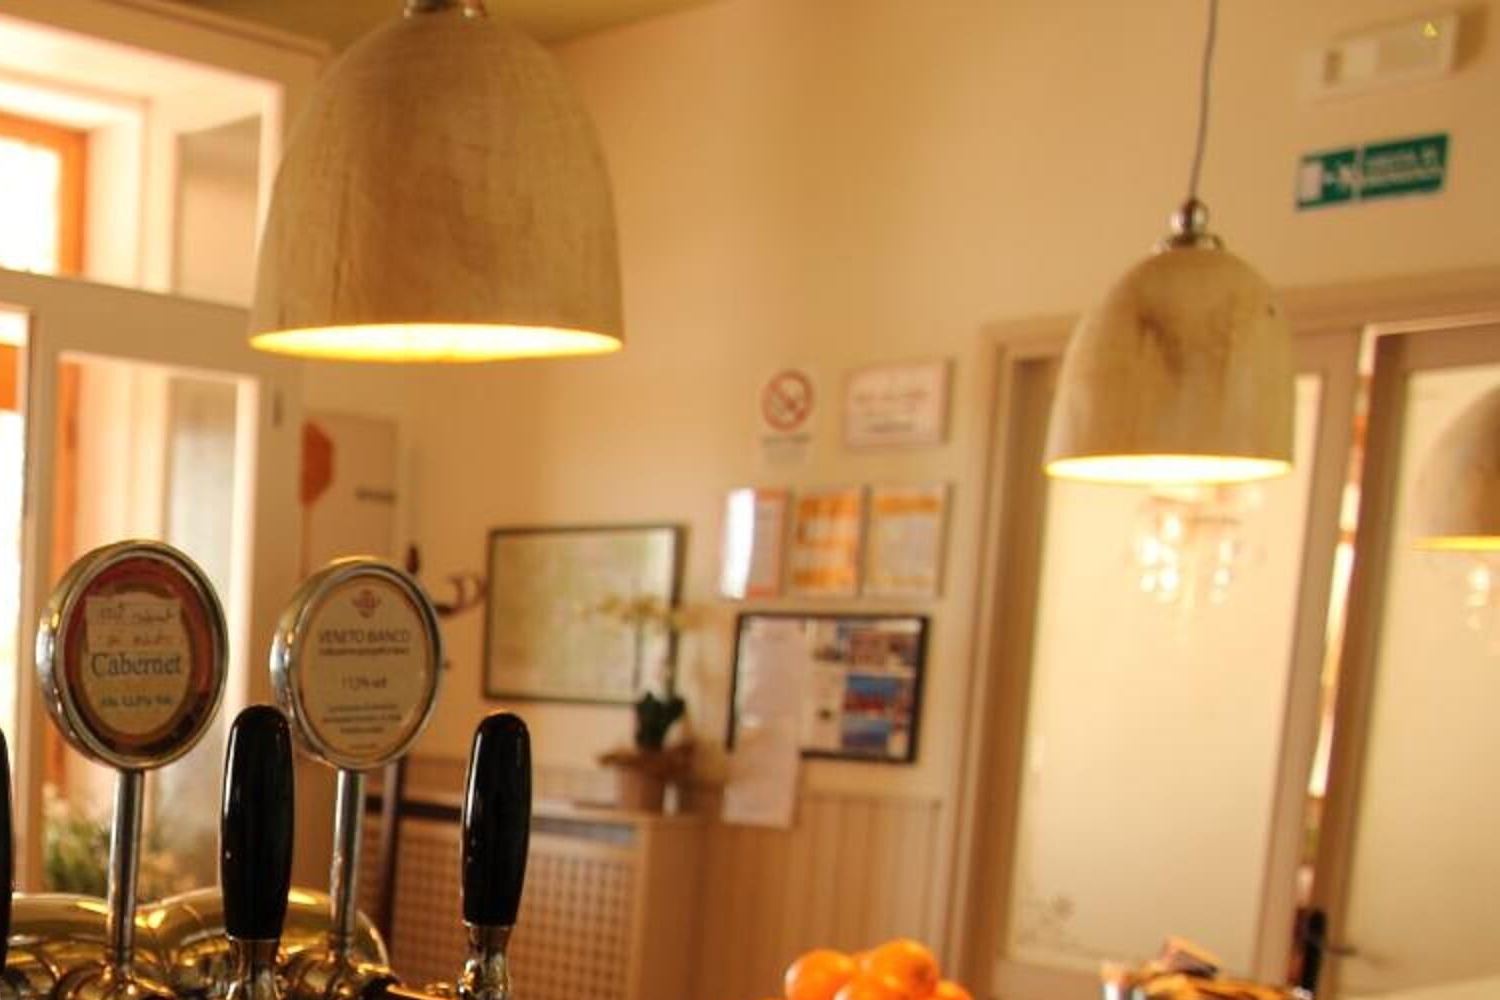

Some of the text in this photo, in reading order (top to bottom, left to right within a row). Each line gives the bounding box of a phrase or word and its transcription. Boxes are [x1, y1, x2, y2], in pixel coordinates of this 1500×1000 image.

[318, 627, 412, 643] VENETO BIANCO
[91, 652, 181, 678] Cabernet
